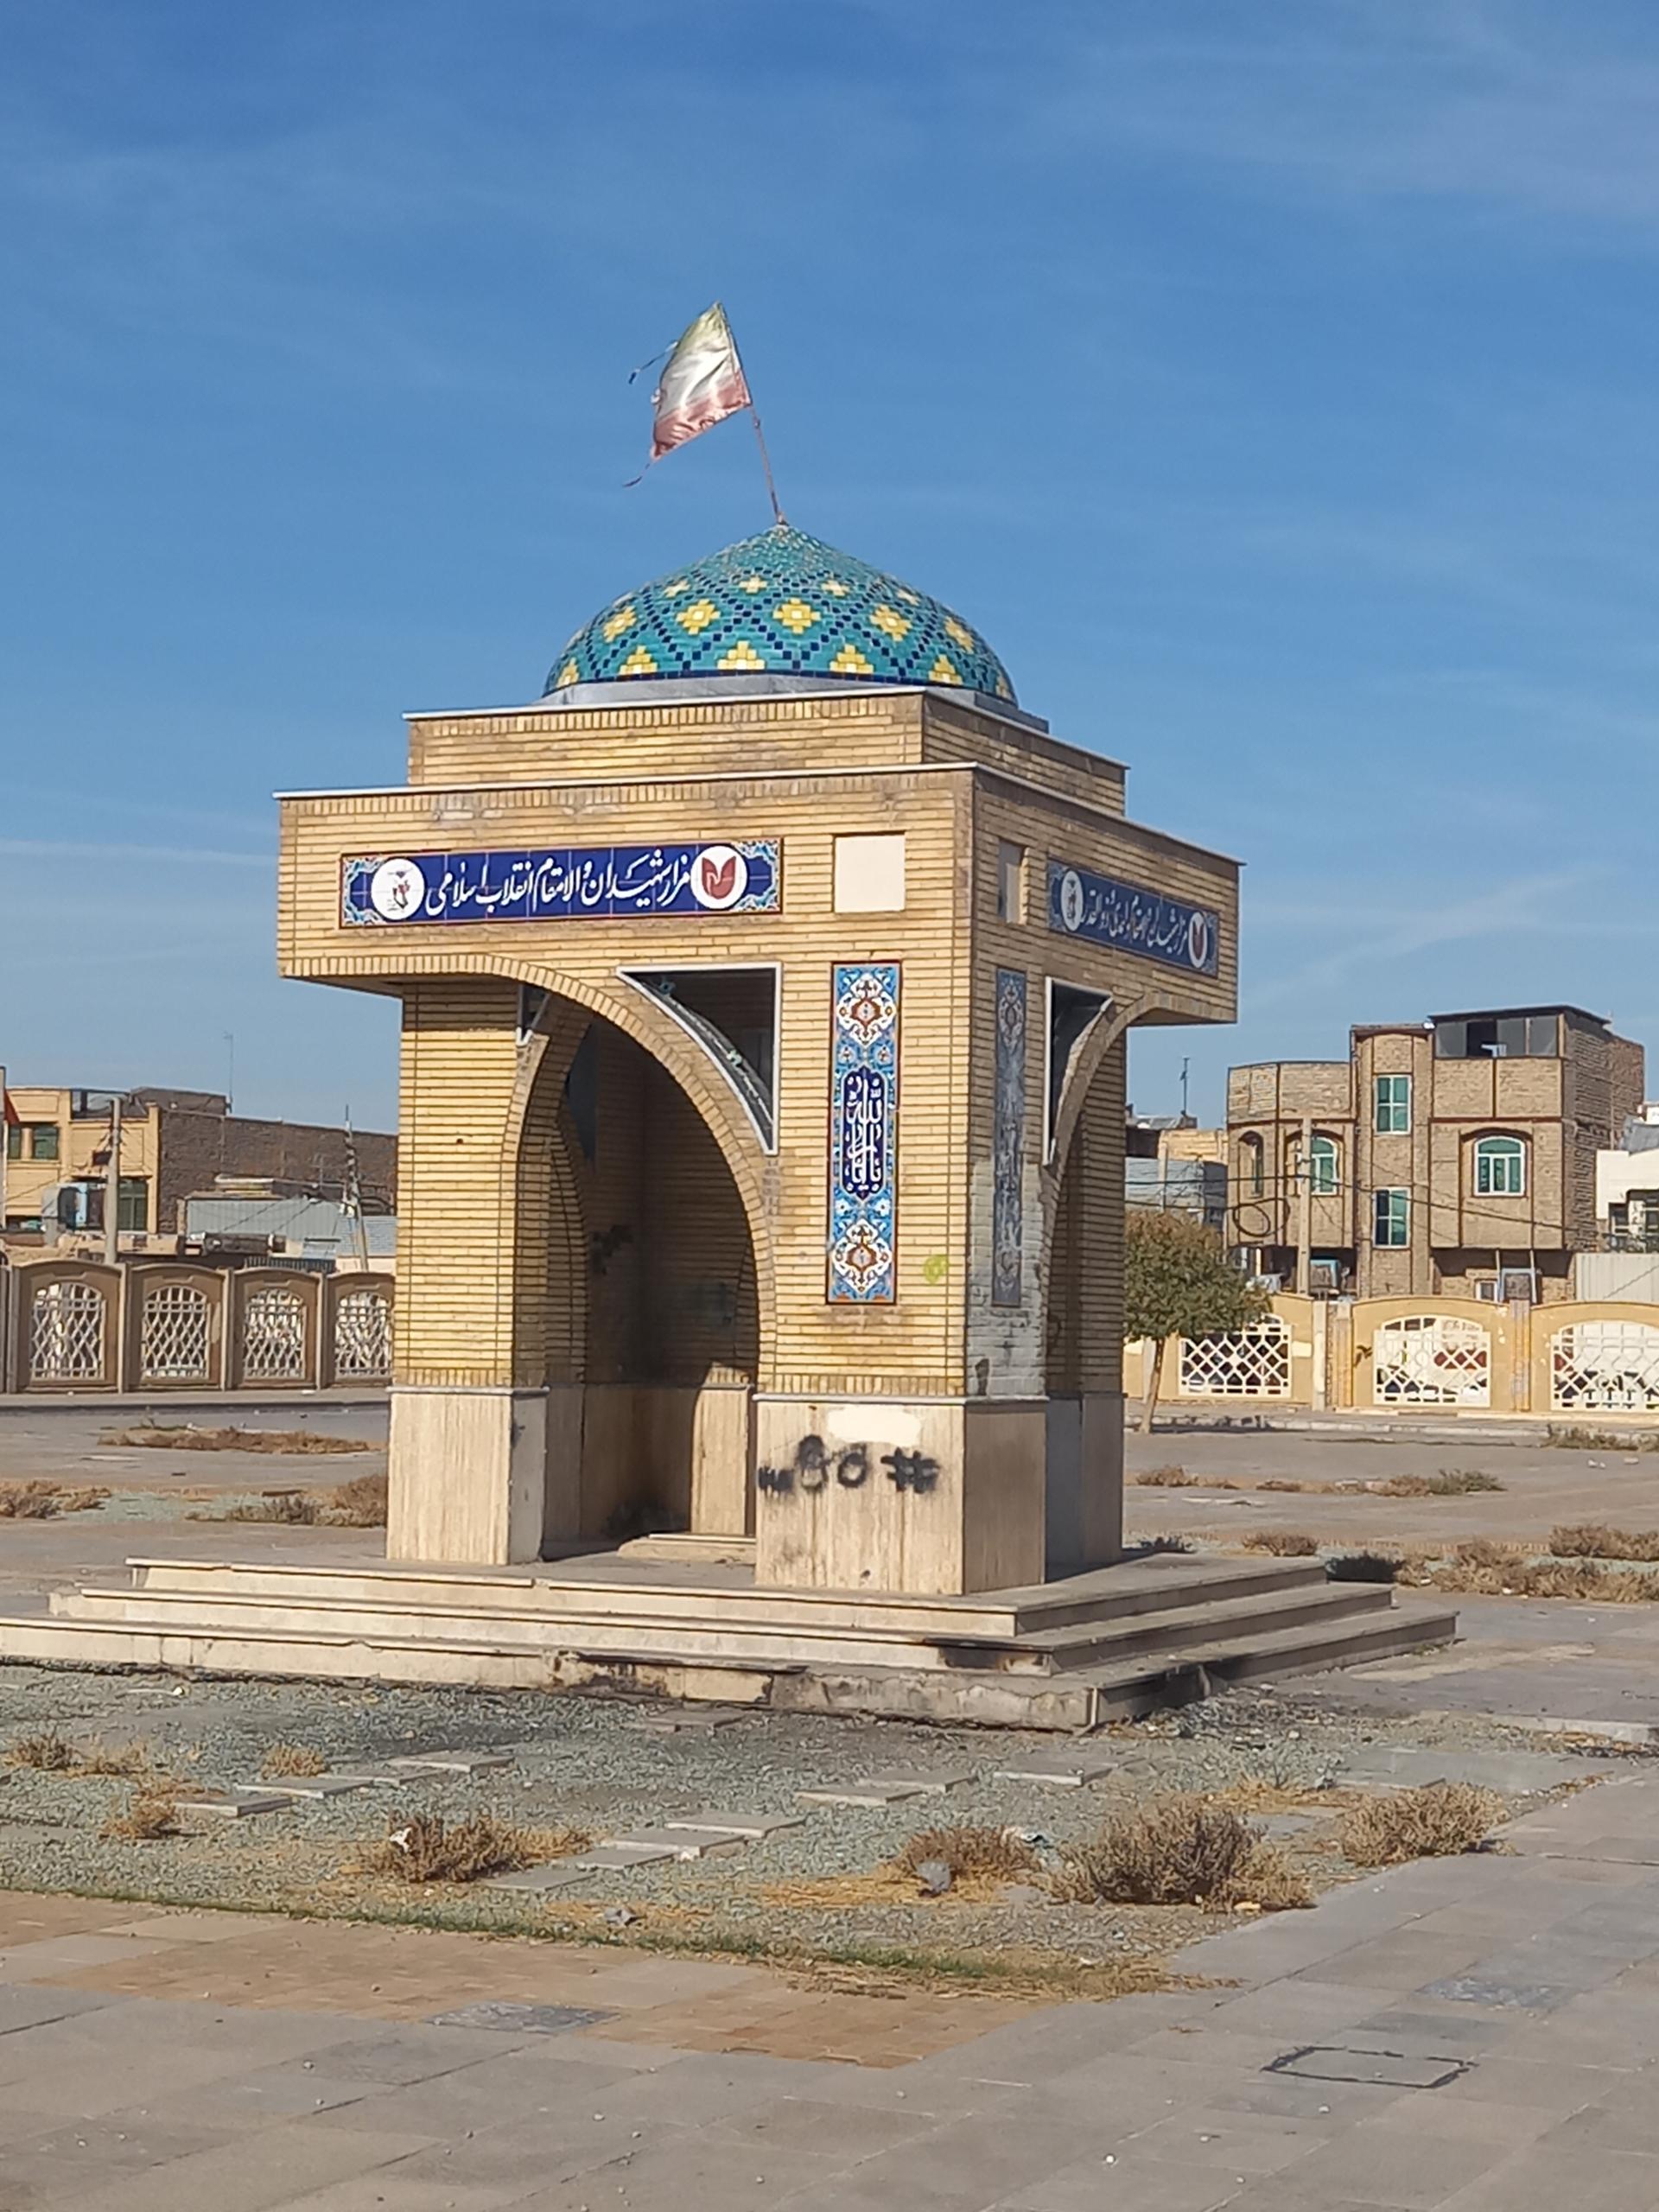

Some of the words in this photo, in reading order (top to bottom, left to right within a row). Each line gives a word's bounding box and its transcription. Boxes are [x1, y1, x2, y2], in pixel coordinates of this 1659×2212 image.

[425, 861, 488, 916] اسلامی
[475, 861, 534, 914] انقلاب
[582, 849, 671, 908] شهیدان
[658, 853, 690, 907] مزار
